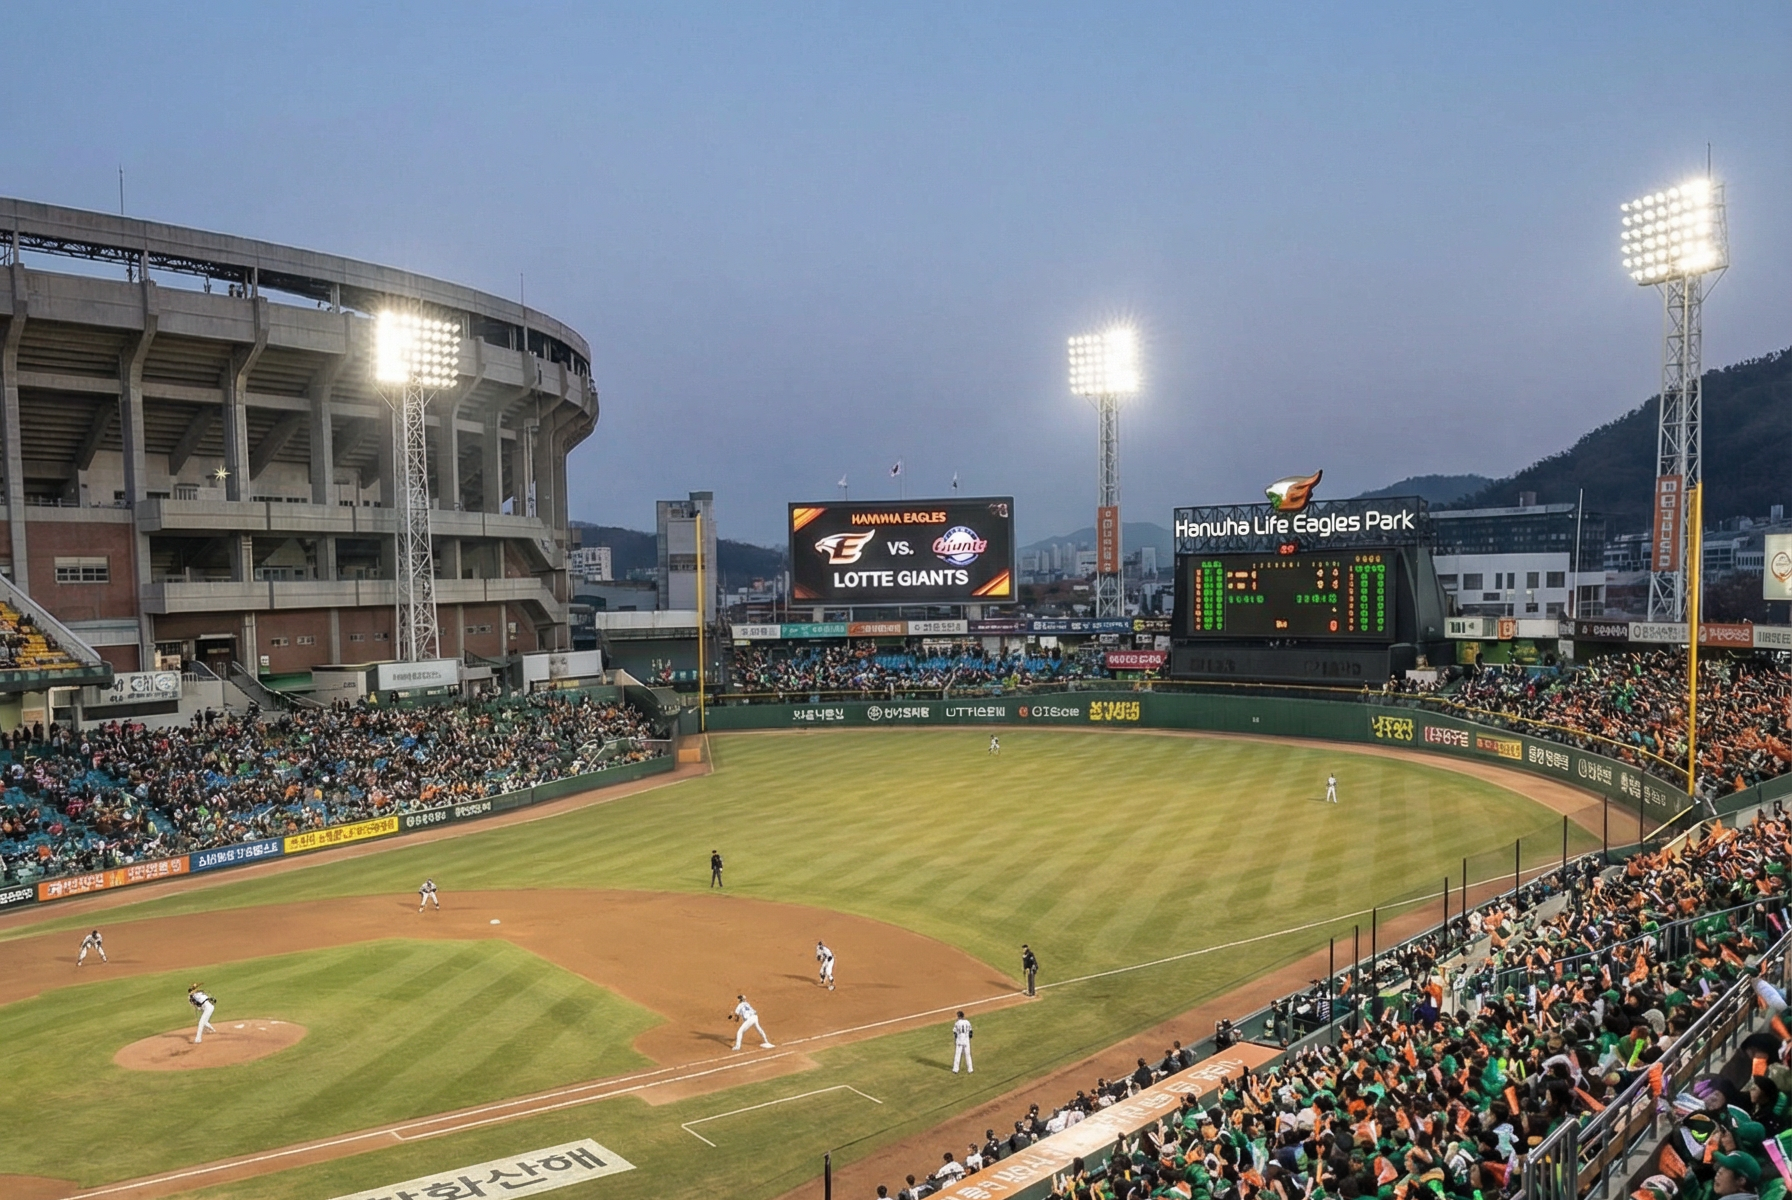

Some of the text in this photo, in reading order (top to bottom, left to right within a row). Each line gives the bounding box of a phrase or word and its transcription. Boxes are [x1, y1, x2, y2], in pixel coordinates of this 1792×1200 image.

[903, 511, 947, 523] EAGLES
[1175, 509, 1415, 538] Hanwha Life Eagles Park
[887, 541, 914, 556] VS.
[833, 569, 969, 588] LOTTE GIANTS
